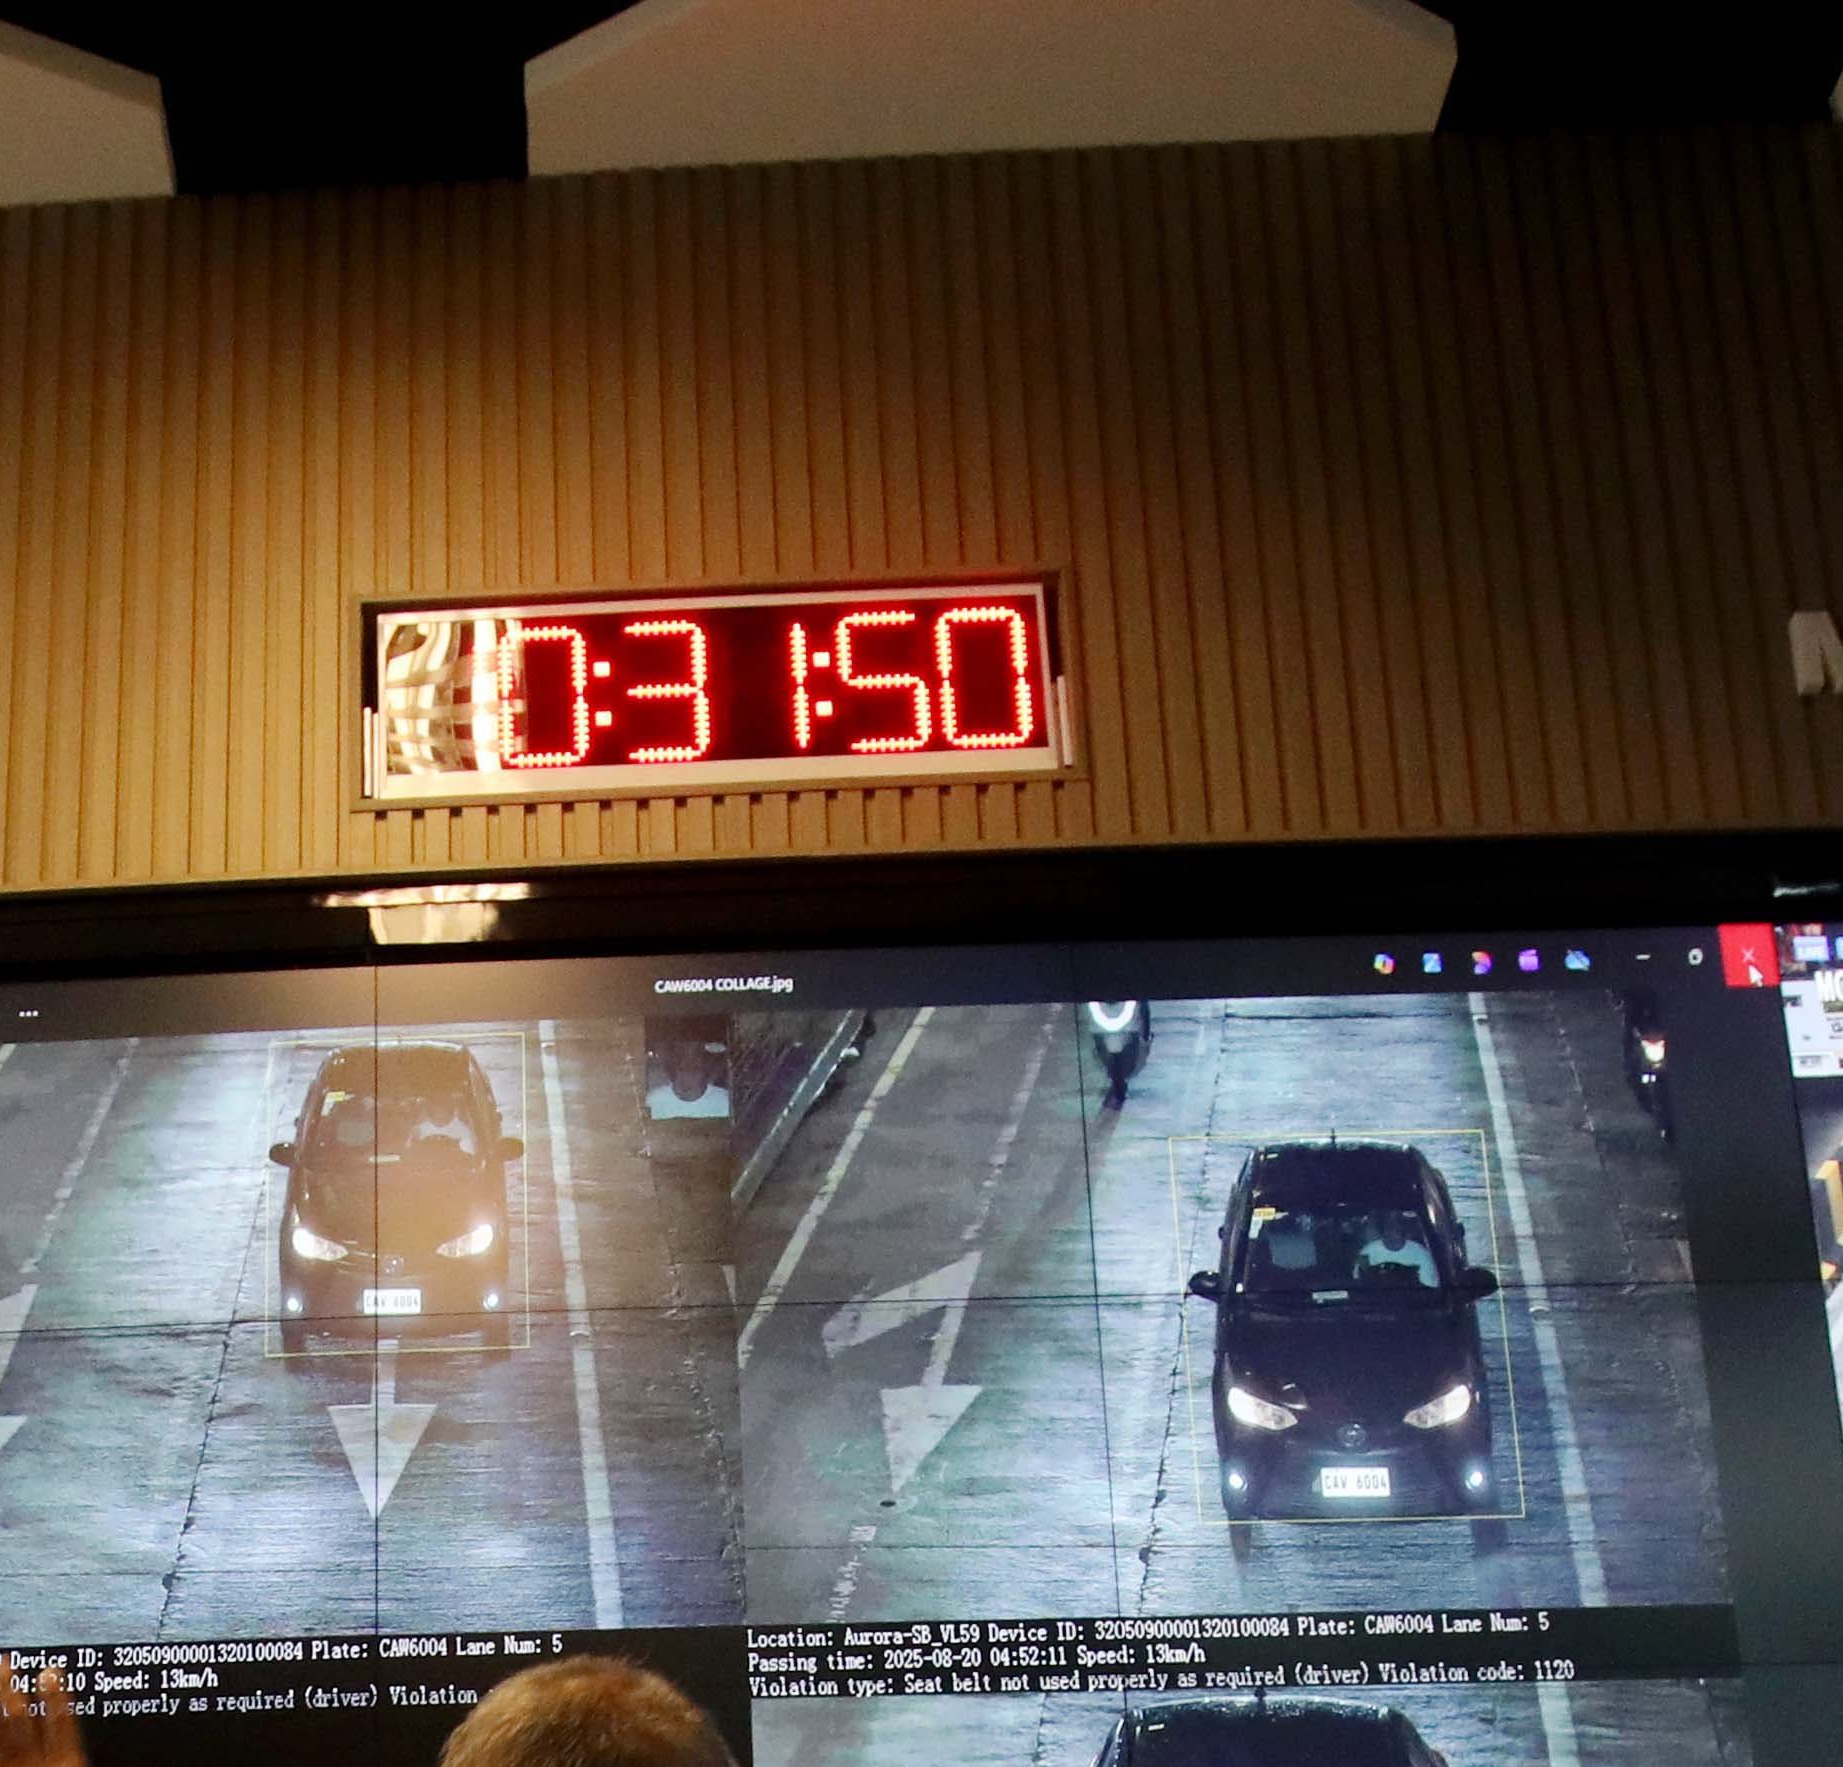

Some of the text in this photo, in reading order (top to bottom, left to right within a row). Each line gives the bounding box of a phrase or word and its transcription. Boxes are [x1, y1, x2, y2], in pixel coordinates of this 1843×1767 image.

[655, 976, 794, 994] CAW6004 COLLAGE.jpg
[748, 1612, 1549, 1649] Location: Aurora-SB_VL59 Device ID: 32050900001320100084 Plate: CAW6004 Lane Num: 5
[11, 1650, 67, 1671] Device
[77, 1648, 103, 1668] ID:
[311, 1641, 369, 1662] Plate:
[379, 1639, 448, 1658] CAW6004
[457, 1638, 495, 1656] Lane
[504, 1636, 541, 1655] Num:
[552, 1634, 563, 1653] 5
[748, 1644, 1206, 1674] Passing time: 2025-08-20 04:52:11 Speed: 13km/h
[95, 1670, 150, 1695] Speed:
[160, 1668, 219, 1690] 13km/h
[749, 1659, 1576, 1698] Violation type: Seat belt not used properly as required (driver) Violation code: 1120
[103, 1694, 180, 1718] properly
[189, 1694, 209, 1713] as
[217, 1690, 294, 1713] required
[306, 1685, 378, 1709] (driver)
[390, 1684, 478, 1706] Violation
